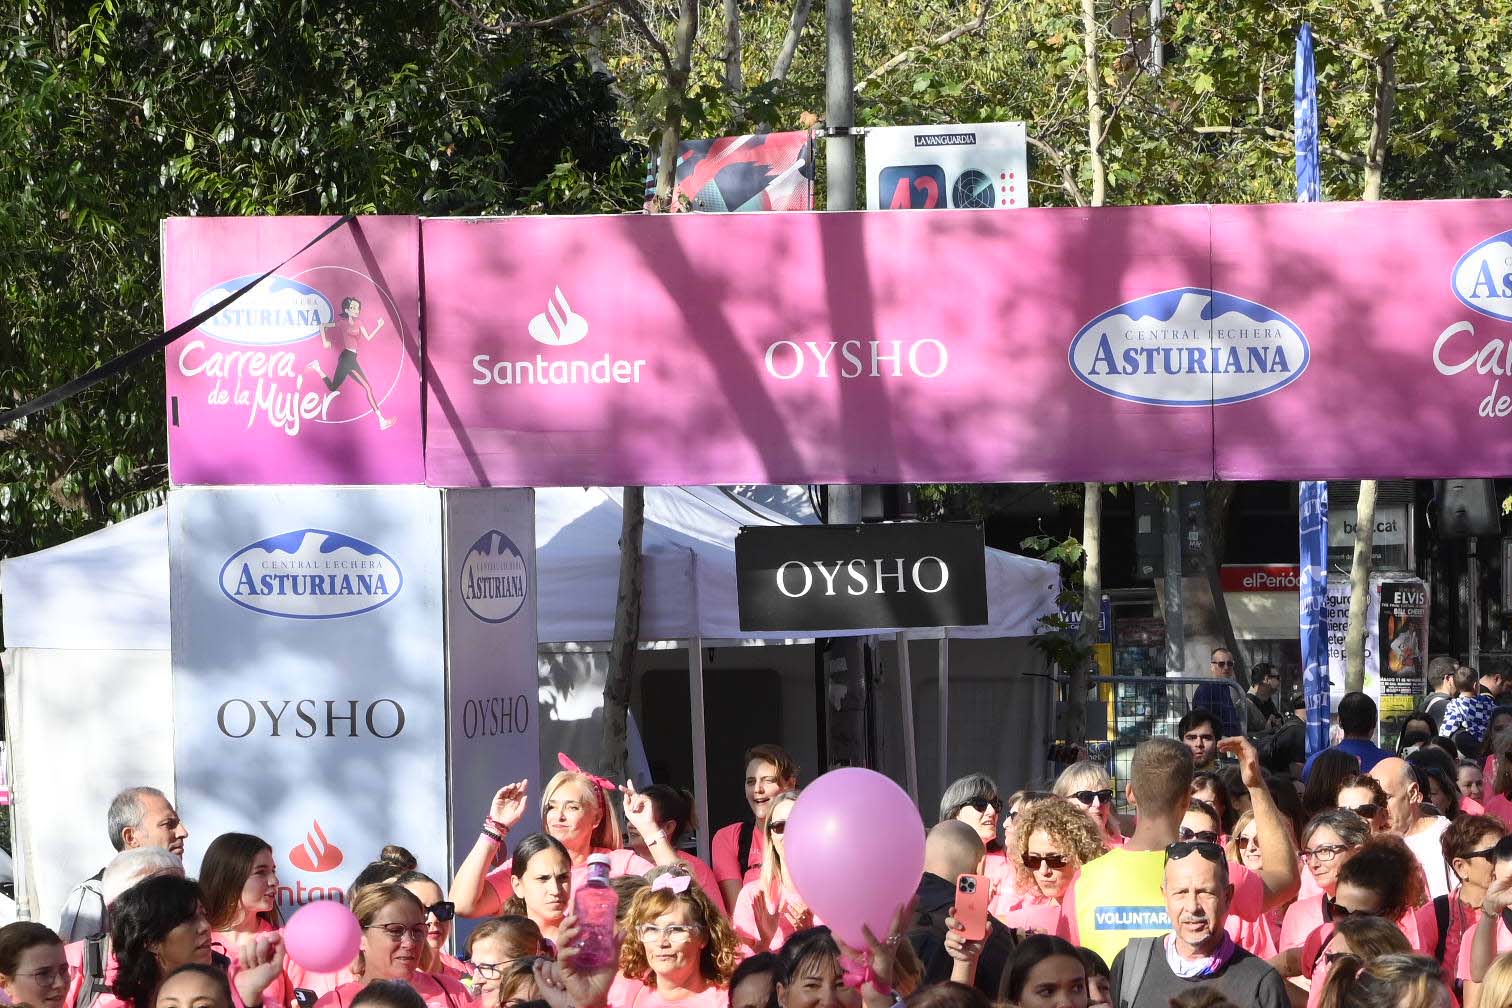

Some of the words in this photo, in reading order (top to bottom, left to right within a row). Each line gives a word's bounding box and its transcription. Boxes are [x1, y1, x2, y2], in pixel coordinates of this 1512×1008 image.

[1088, 331, 1292, 376] ASTURIANA
[1125, 329, 1201, 341] CENTRAL
[179, 340, 296, 377] Carrera
[473, 354, 646, 385] Santander
[765, 339, 949, 379] OYSHO
[208, 384, 231, 405] de
[233, 380, 250, 404] la
[248, 375, 341, 436] Mujer
[1479, 379, 1512, 418] de
[234, 562, 389, 596] ASTURIANA
[261, 560, 318, 569] CENTRAL
[325, 560, 383, 569] LECHERA
[466, 564, 524, 600] ASTURIANA
[776, 555, 950, 598] OYSHO
[1394, 592, 1425, 604] ELVIS
[217, 699, 405, 739] OYSHO
[463, 694, 529, 739] OYSHO
